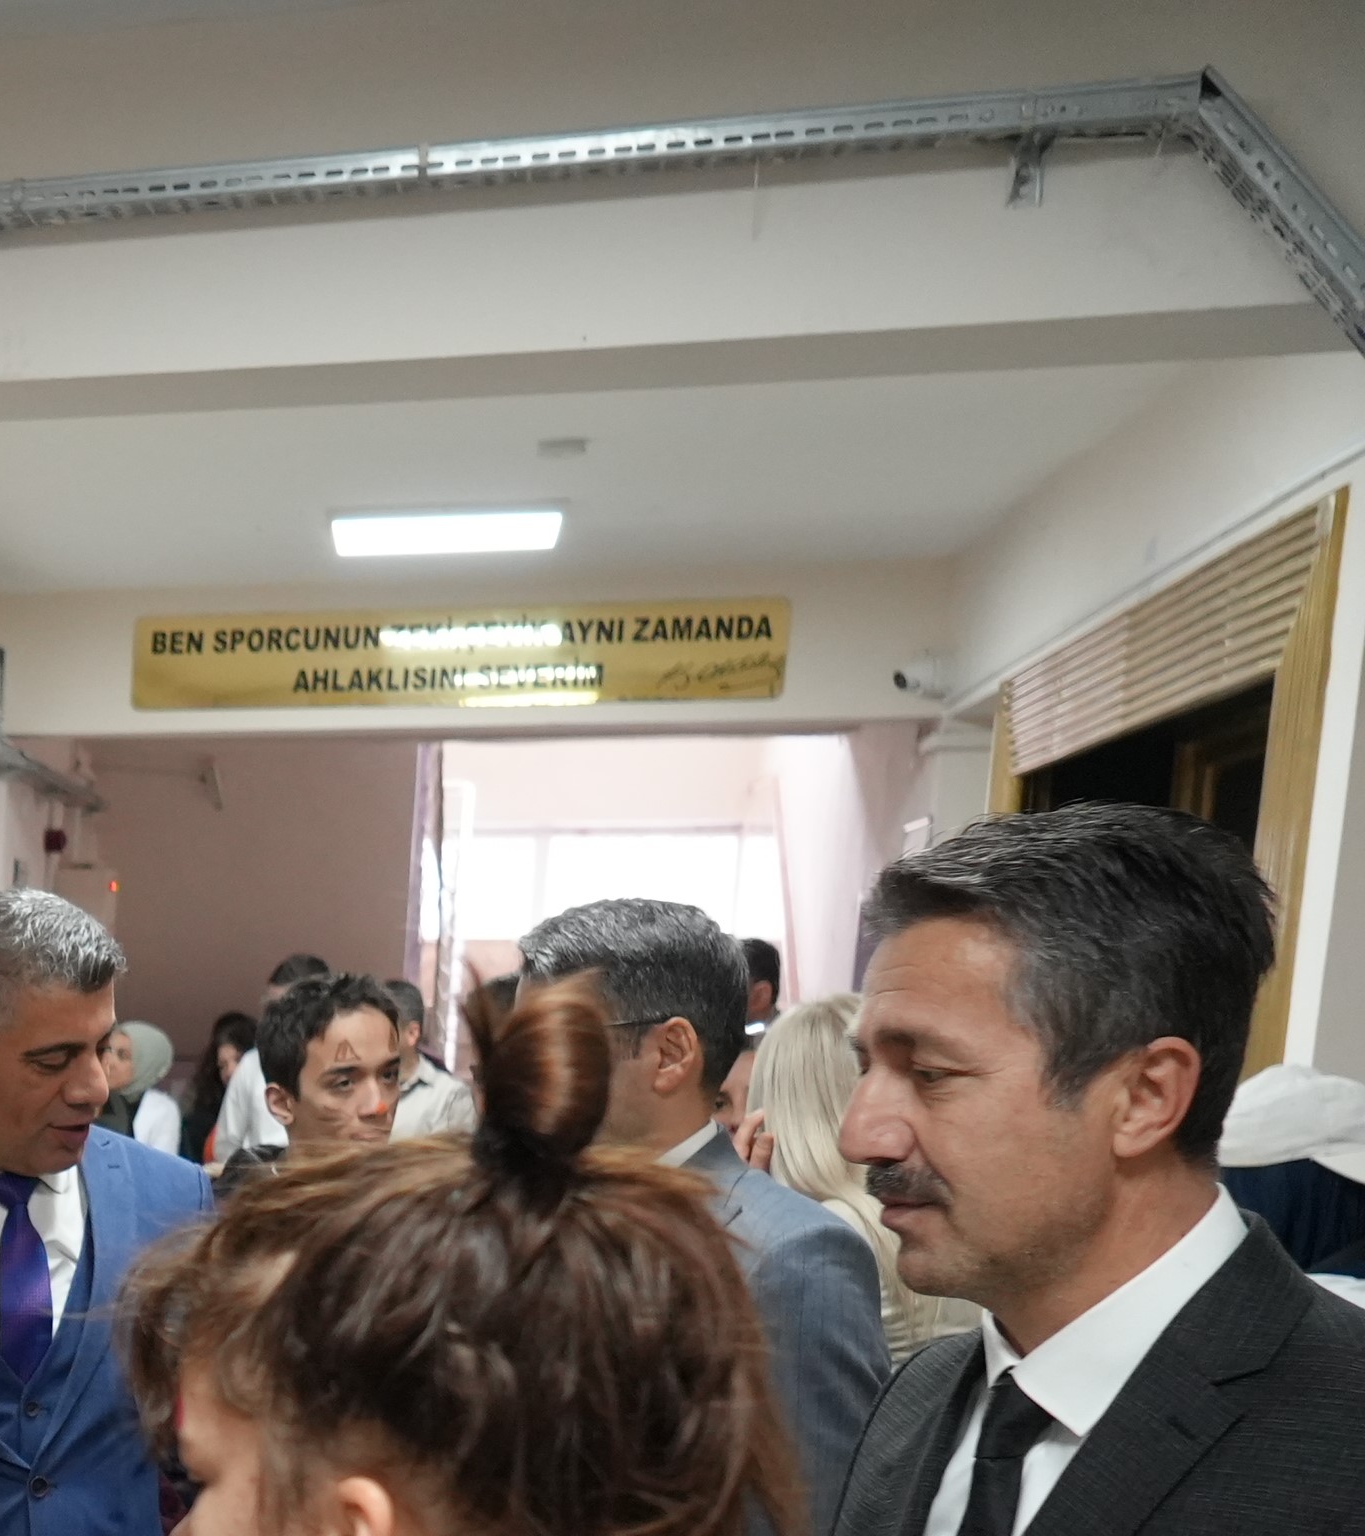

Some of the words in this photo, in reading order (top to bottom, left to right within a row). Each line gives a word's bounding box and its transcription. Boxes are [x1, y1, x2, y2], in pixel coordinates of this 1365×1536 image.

[151, 628, 204, 655] BEN
[213, 623, 381, 654] SPORCUNUN
[561, 617, 625, 646] AYNI
[632, 613, 773, 642] ZAMANDA
